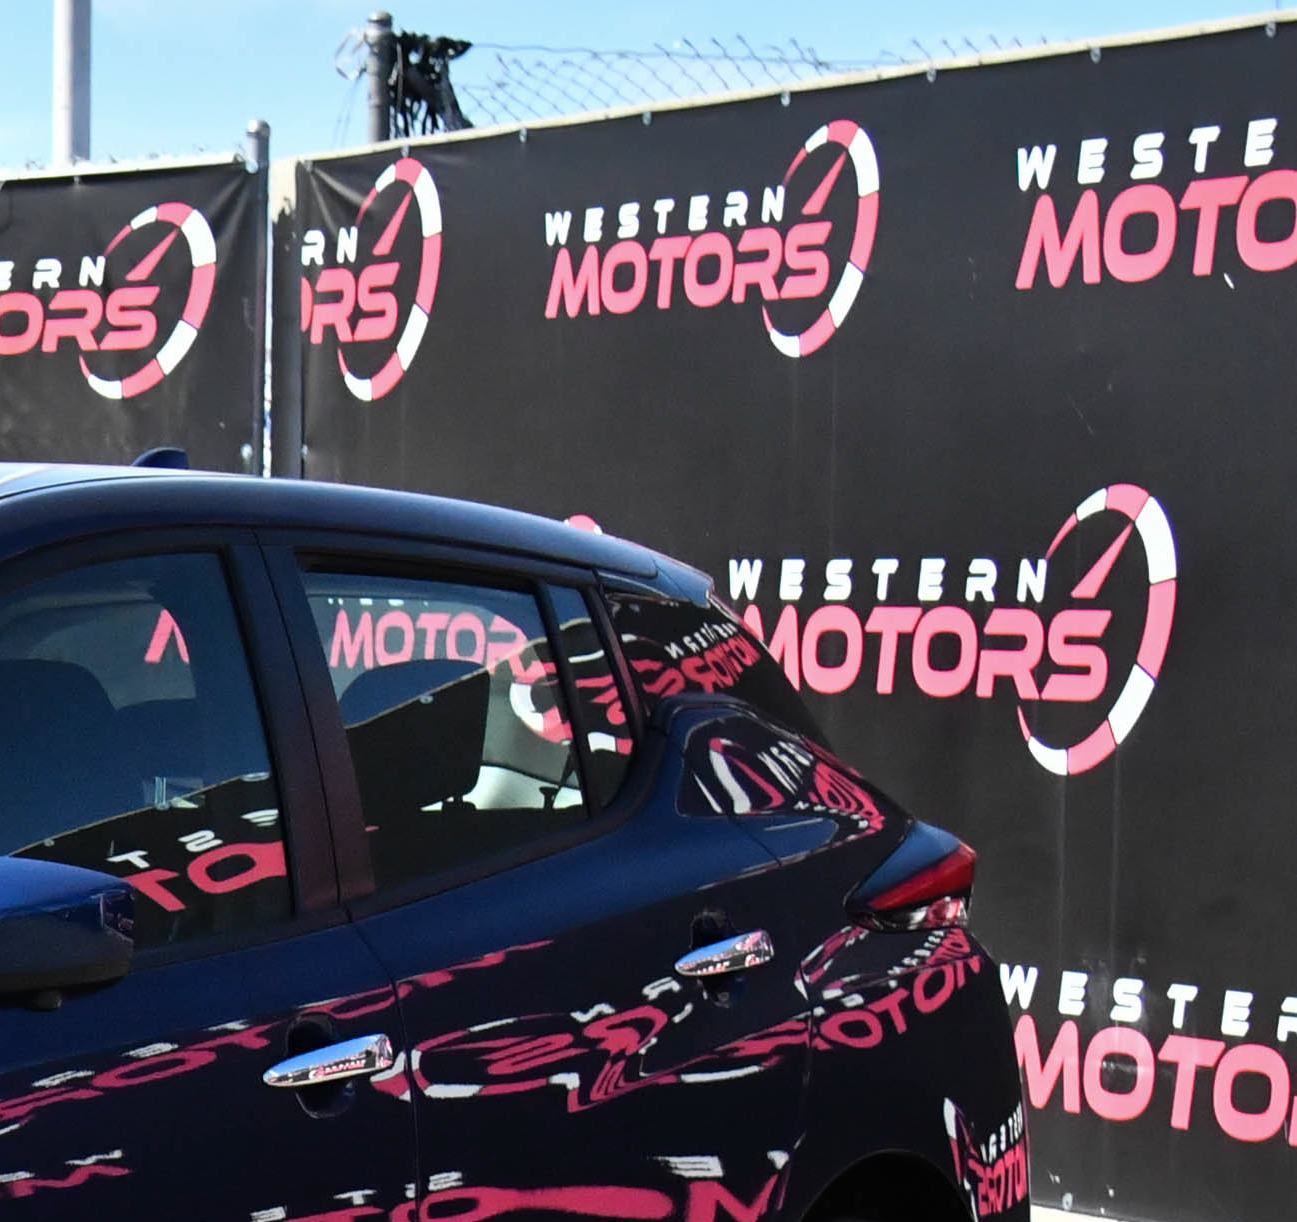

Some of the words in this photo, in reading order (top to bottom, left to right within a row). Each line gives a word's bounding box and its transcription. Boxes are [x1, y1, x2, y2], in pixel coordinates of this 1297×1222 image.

[1018, 118, 1278, 191] WESTE
[545, 185, 785, 246] WESTERN
[1015, 169, 1297, 290] MOTO
[301, 262, 401, 344] RS
[545, 221, 833, 319] MOTORS
[729, 559, 1047, 602] WESTERN
[739, 604, 1112, 701] MOTORS
[1014, 1014, 1297, 1147] MOTO
